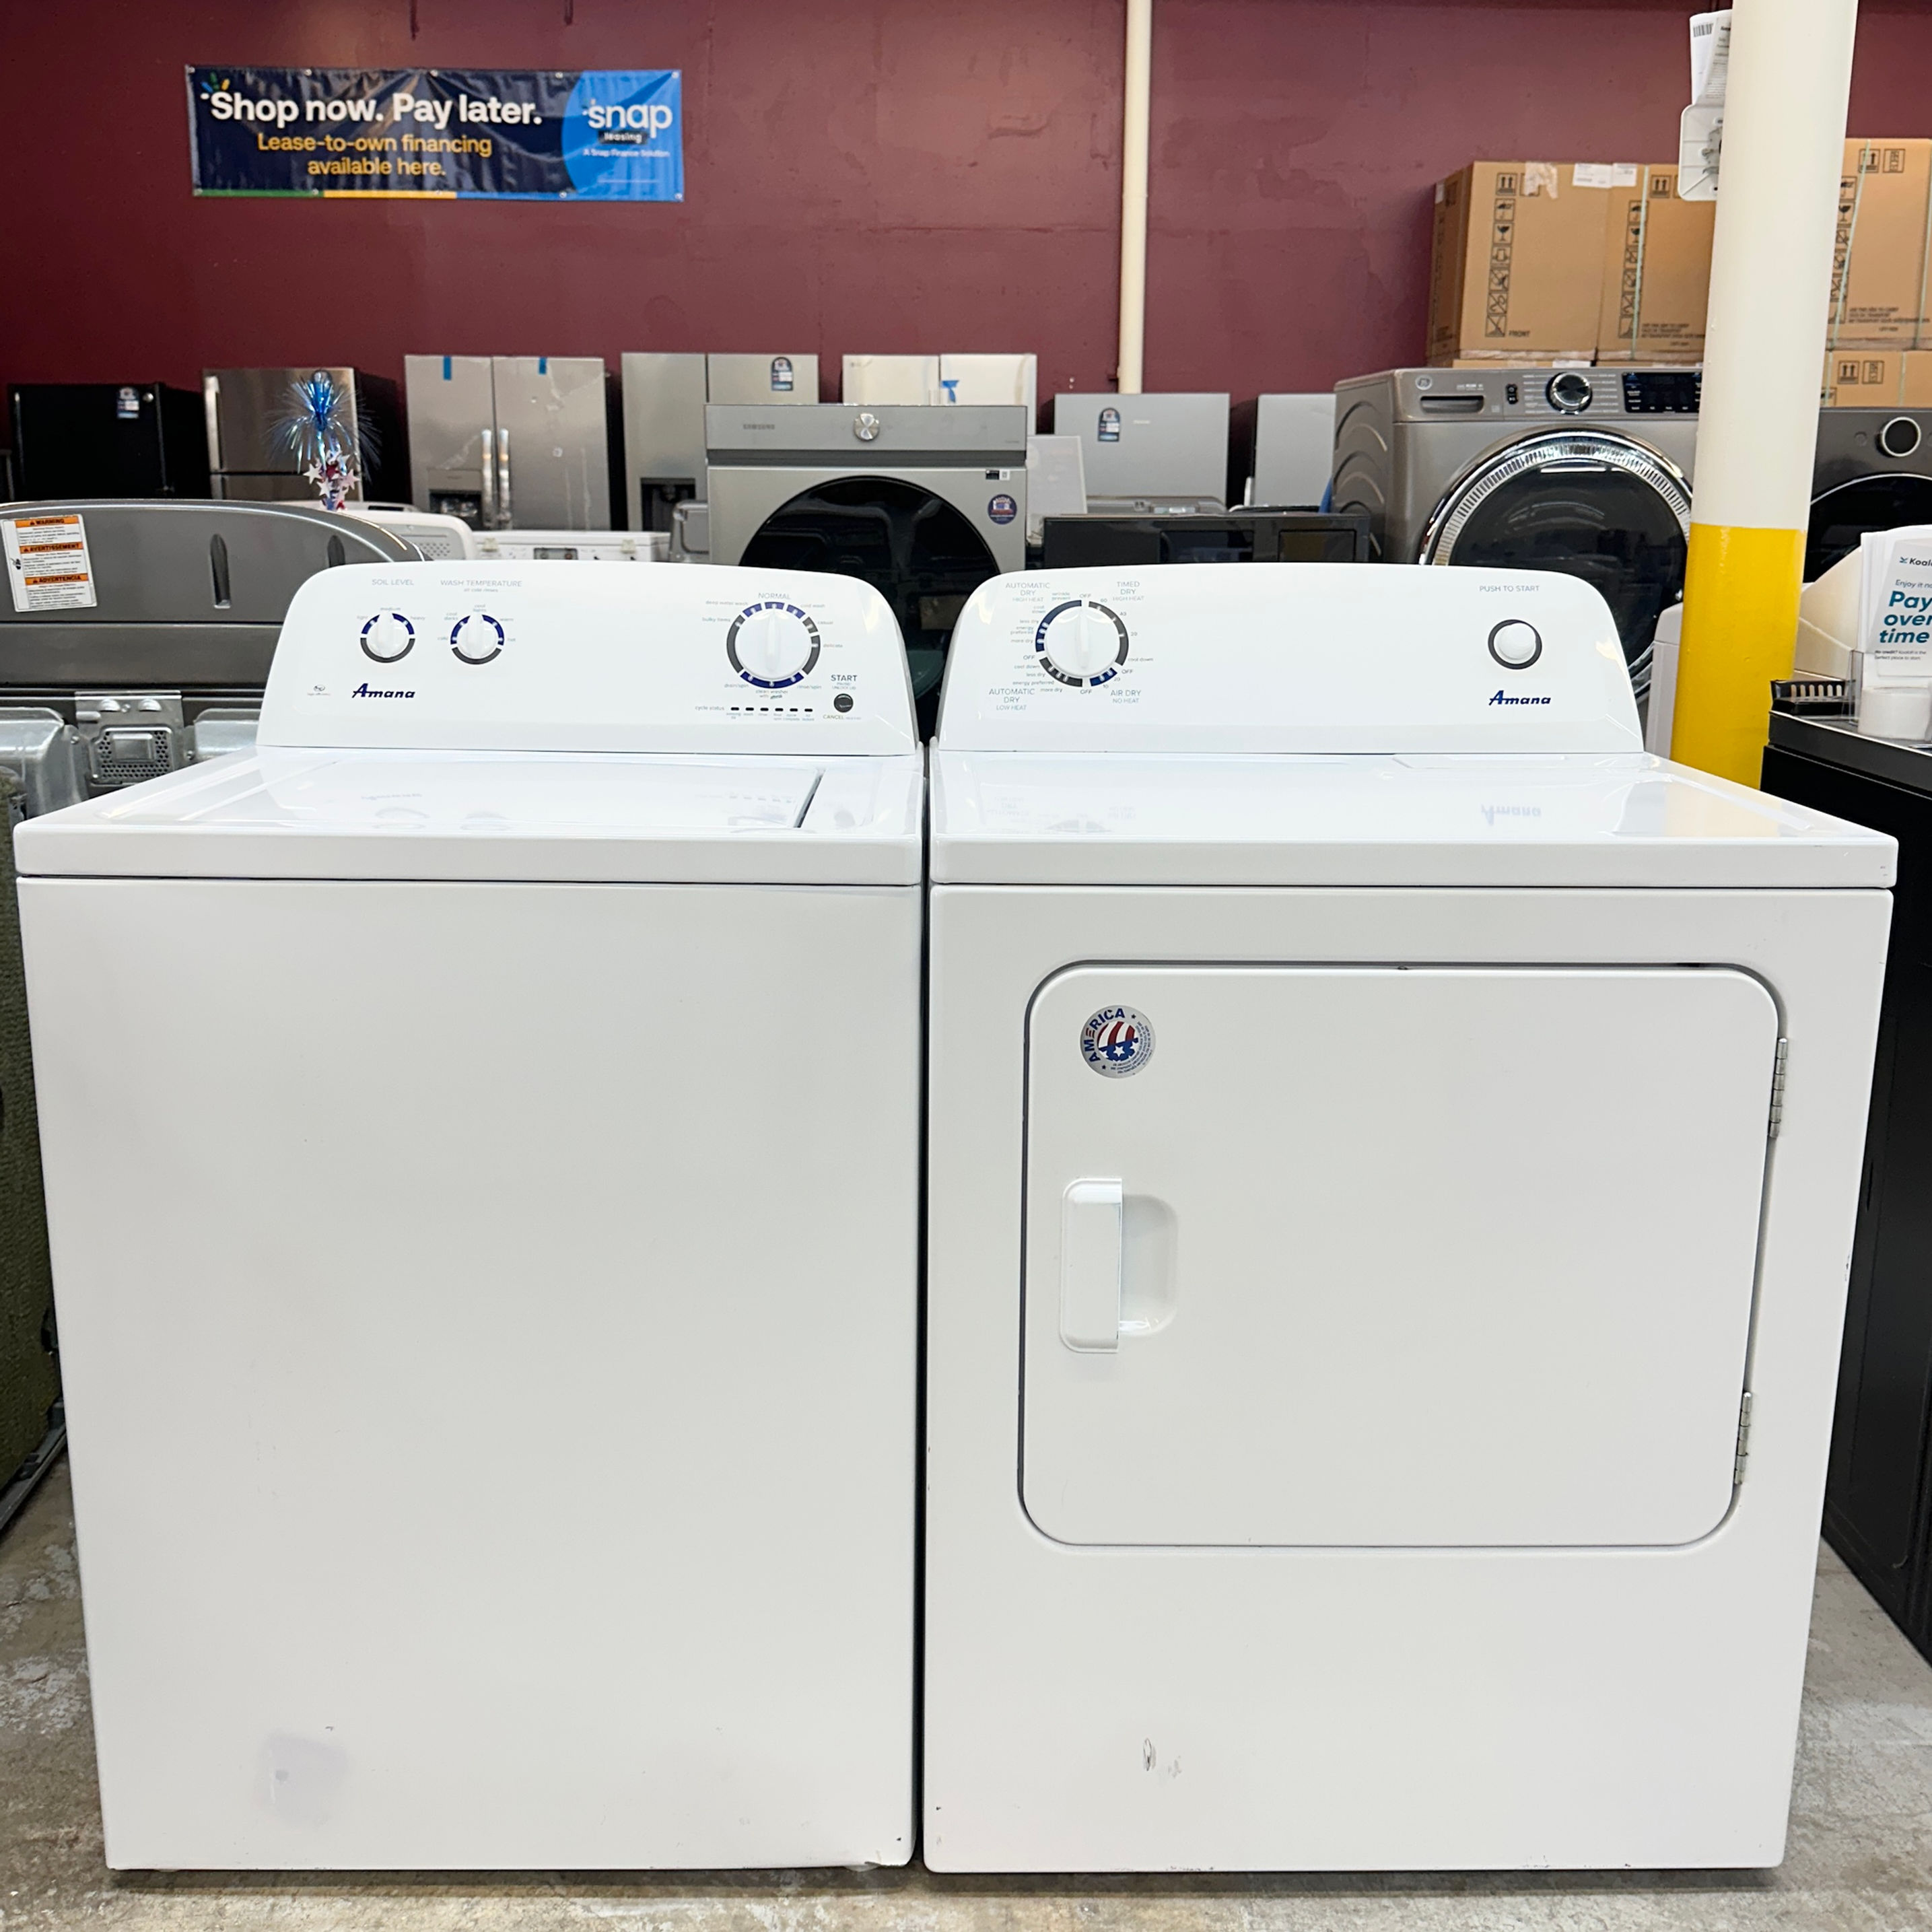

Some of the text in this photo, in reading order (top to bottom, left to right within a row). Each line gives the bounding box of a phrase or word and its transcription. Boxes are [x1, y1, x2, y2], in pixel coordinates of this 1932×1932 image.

[211, 92, 543, 130] Shop now. Pay later.
[588, 104, 673, 139] snap
[257, 133, 492, 158] Lease-to-own financing
[307, 158, 446, 176] available here.
[30, 543, 80, 552] AVERTISSEMENT
[1895, 579, 1917, 588] Enjoy
[1888, 590, 1932, 612] Pay
[1884, 613, 1932, 627] over
[1879, 628, 1930, 644] time
[351, 683, 416, 699] Amana
[1488, 689, 1552, 706] Amana
[1083, 1008, 1126, 1062] AMERICA
